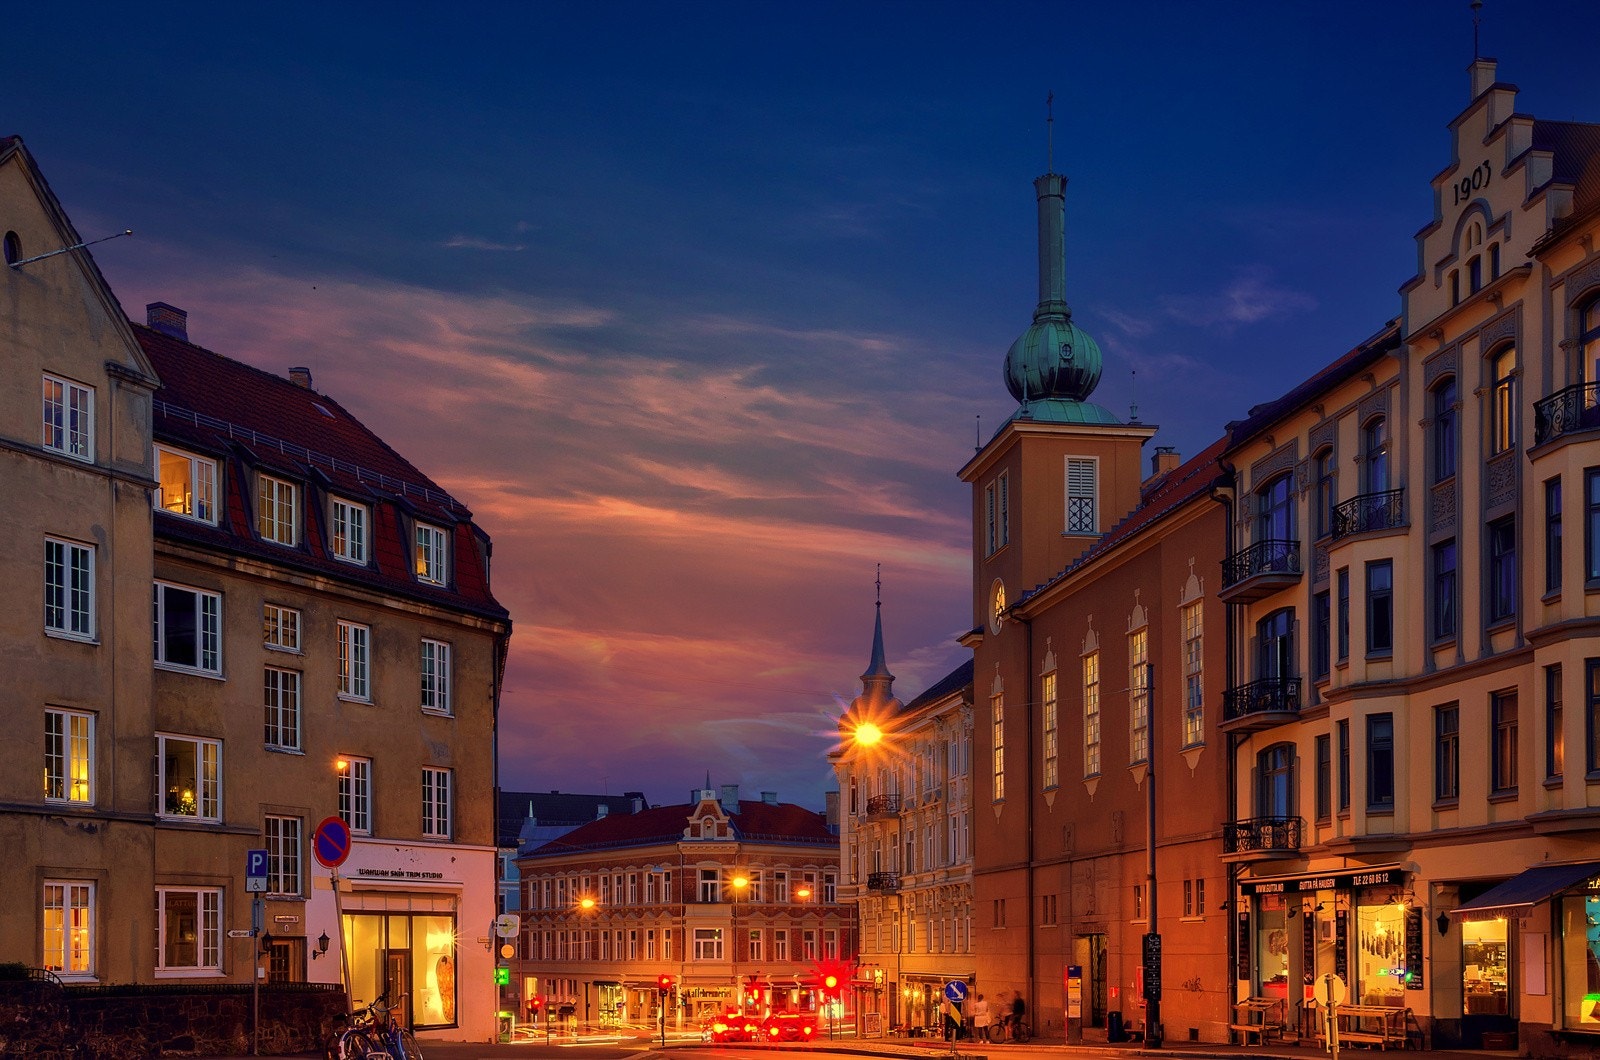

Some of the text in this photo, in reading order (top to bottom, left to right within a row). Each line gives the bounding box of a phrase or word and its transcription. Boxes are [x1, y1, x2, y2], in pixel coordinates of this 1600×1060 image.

[1453, 159, 1491, 206] 1903
[252, 854, 263, 874] P
[1362, 875, 1369, 885] 22
[1382, 872, 1389, 883] 12
